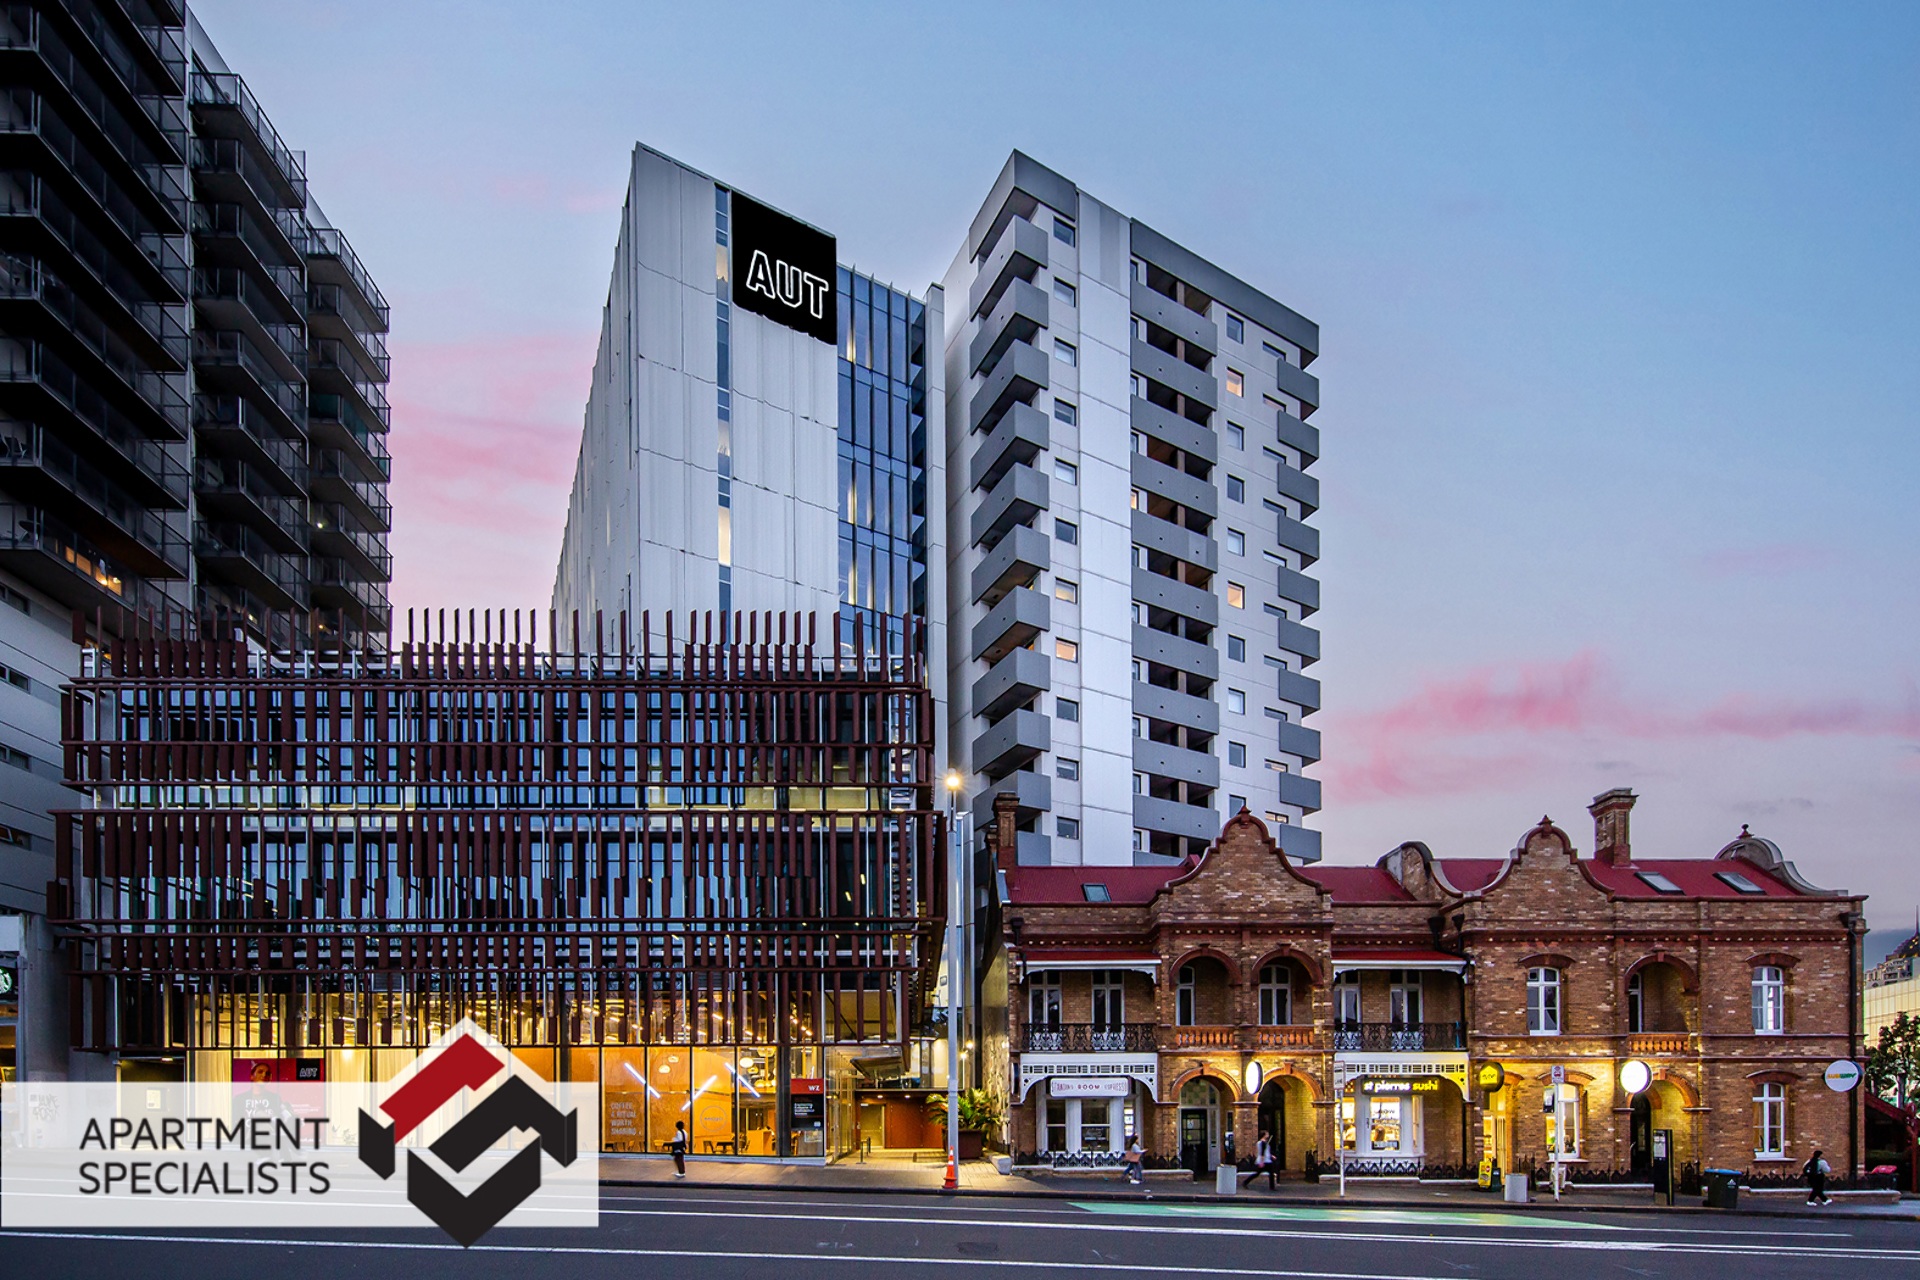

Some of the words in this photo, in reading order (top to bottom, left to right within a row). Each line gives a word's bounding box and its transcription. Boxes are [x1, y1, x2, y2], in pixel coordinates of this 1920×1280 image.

[746, 249, 829, 319] AUT
[299, 1067, 318, 1077] AUT
[1363, 1081, 1374, 1091] st
[1375, 1080, 1411, 1092] pierres
[1412, 1080, 1438, 1091] sushi
